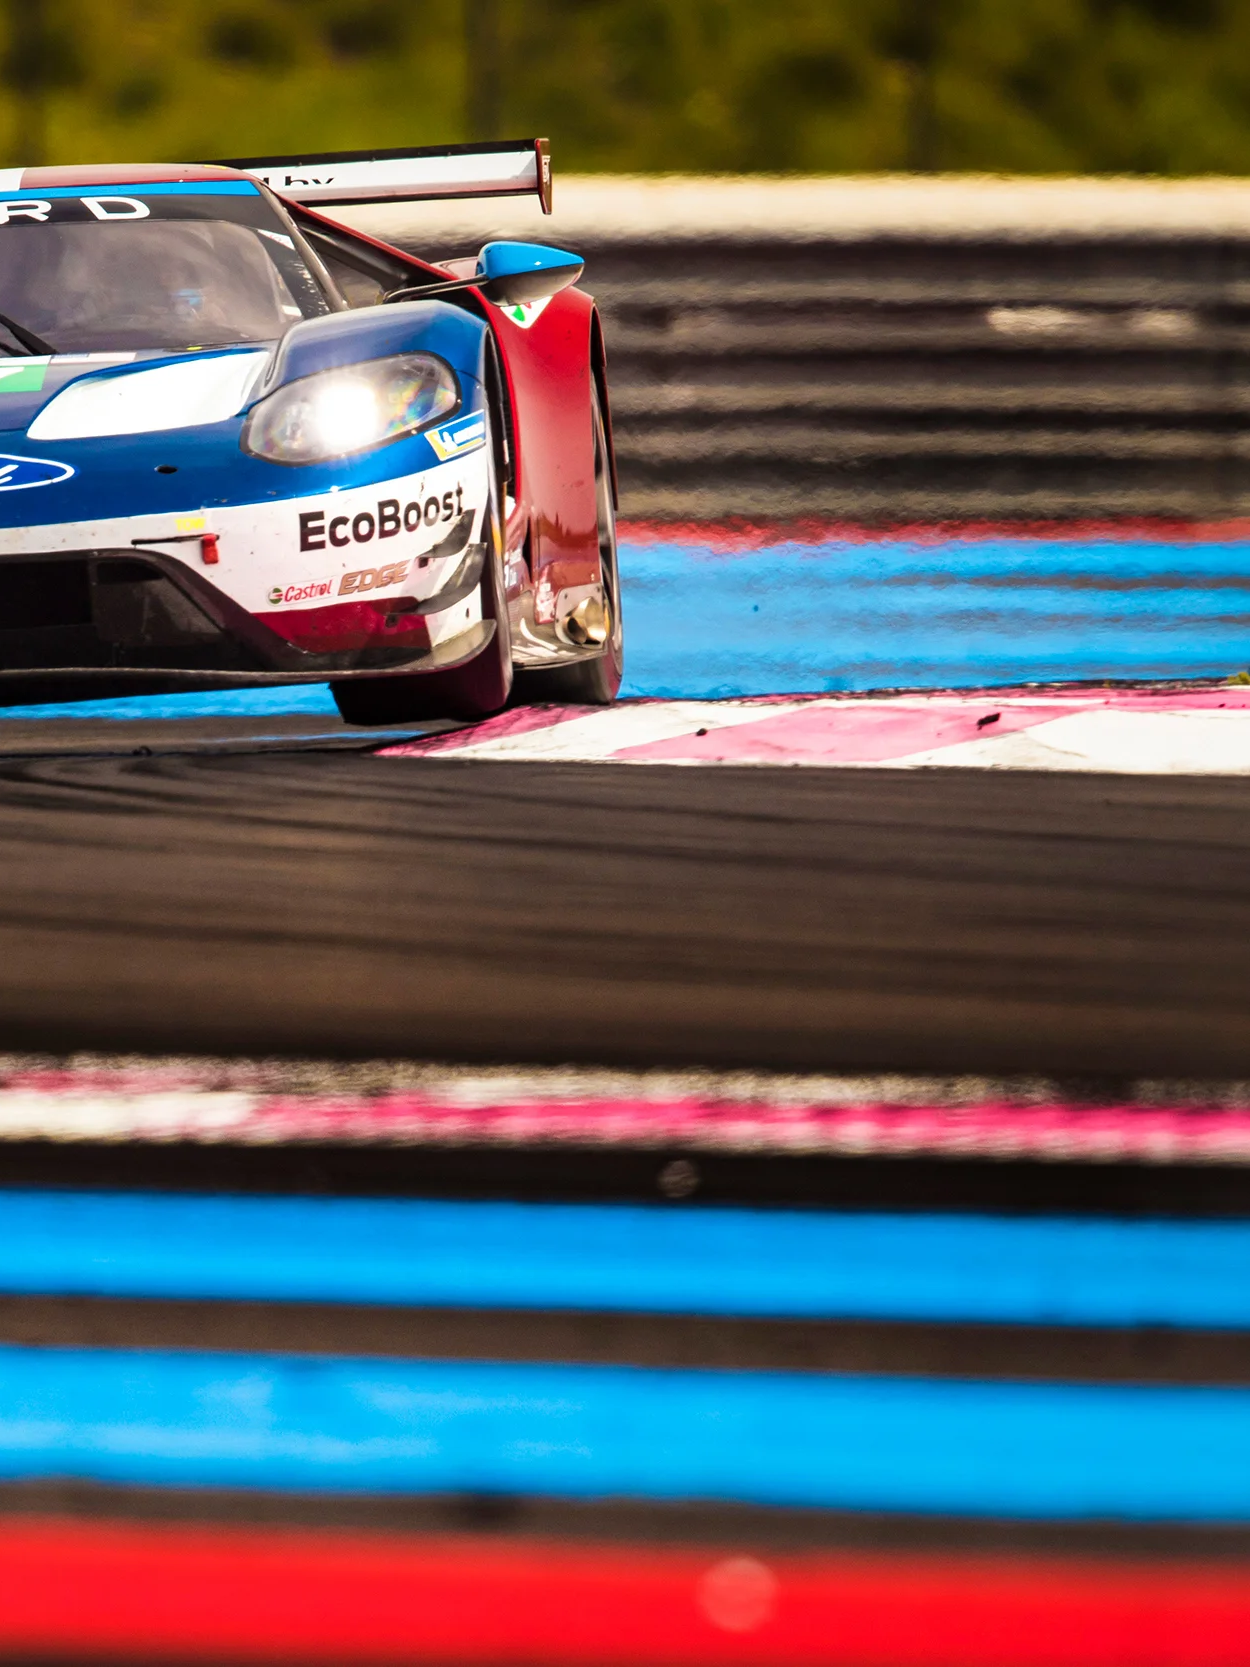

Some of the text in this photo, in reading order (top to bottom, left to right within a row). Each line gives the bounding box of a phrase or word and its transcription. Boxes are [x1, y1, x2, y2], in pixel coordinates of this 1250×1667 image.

[175, 518, 206, 532] TOW
[299, 481, 464, 552] EcoBoost
[284, 559, 412, 602] Castrol EDGE
